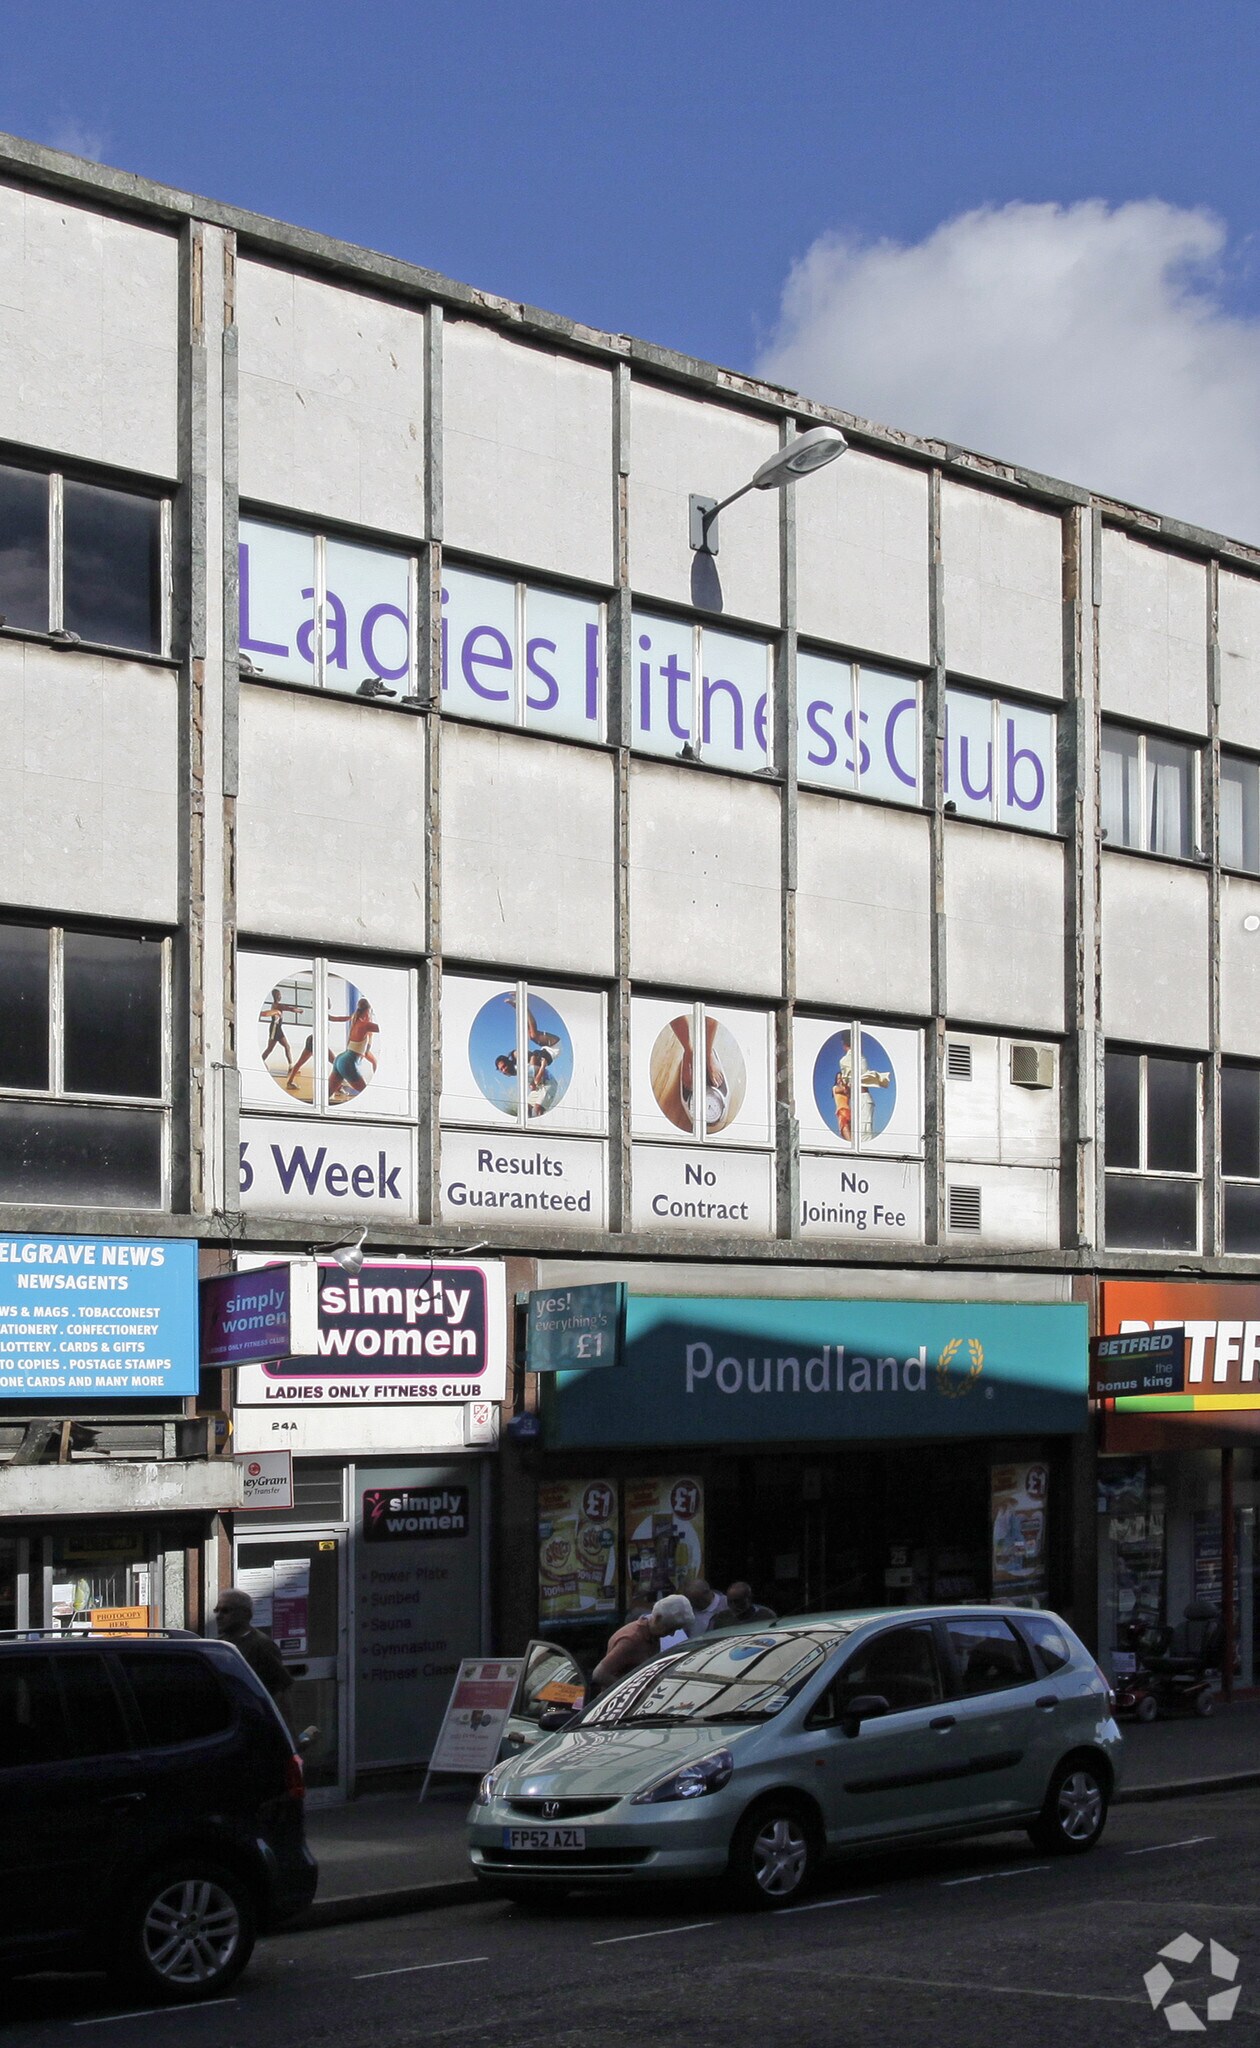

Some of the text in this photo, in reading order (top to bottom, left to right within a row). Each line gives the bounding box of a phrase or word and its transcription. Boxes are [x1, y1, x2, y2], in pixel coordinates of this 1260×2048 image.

[585, 622, 871, 775] itnss
[270, 1143, 402, 1199] Week
[477, 1148, 563, 1177] Results
[685, 1163, 717, 1187] No
[840, 1172, 869, 1194] No
[447, 1181, 591, 1213] Guaranteed
[651, 1194, 749, 1221] Contract
[800, 1200, 906, 1230] Joining Fee
[101, 1245, 165, 1267] NEWS
[17, 1273, 129, 1291] NEWSAGENTS
[225, 1288, 286, 1315] simply
[321, 1278, 471, 1325] simply
[536, 1292, 571, 1318] yes!
[20, 1306, 31, 1317] &
[33, 1306, 70, 1318] MAGS
[78, 1307, 161, 1318] TOBACCONEST
[221, 1310, 288, 1334] women
[535, 1312, 608, 1332] everything's
[66, 1324, 159, 1335] CONFECTIONERY
[0, 1341, 146, 1353] LOTTERY CARDS & GIFTS
[227, 1343, 243, 1352] ONLY
[243, 1339, 269, 1349] FITNESS
[317, 1327, 477, 1356] women
[576, 1332, 603, 1359] £1
[1098, 1335, 1173, 1357] BETFRED
[17, 1358, 60, 1370] COPIES
[69, 1358, 123, 1370] POSTAGE
[124, 1358, 172, 1370] STAMPS
[686, 1341, 927, 1394] Poundland
[1155, 1362, 1173, 1374] the
[26, 1375, 66, 1387] CARDS
[68, 1375, 93, 1387] AND
[95, 1375, 129, 1387] MANY
[131, 1375, 165, 1387] MORE
[265, 1383, 482, 1399] LADIES ONLY FITNESS CLUB
[1096, 1376, 1173, 1392] bonus king
[271, 1421, 299, 1431] 24A
[254, 1487, 280, 1496] Transfer
[1028, 1471, 1047, 1494] £1
[389, 1492, 462, 1515] simply
[586, 1489, 611, 1517] £1
[674, 1486, 698, 1514] £1
[386, 1514, 465, 1532] women
[370, 1566, 448, 1583] Power Plate
[370, 1590, 421, 1607] Sunbed
[96, 1611, 141, 1621] PHOTOCOPY
[109, 1621, 129, 1629] HERE
[370, 1617, 412, 1631] Sauna
[371, 1639, 448, 1658] Gymnasium
[371, 1663, 460, 1681] Fitness Class
[511, 1831, 583, 1847] FP52 AZL
